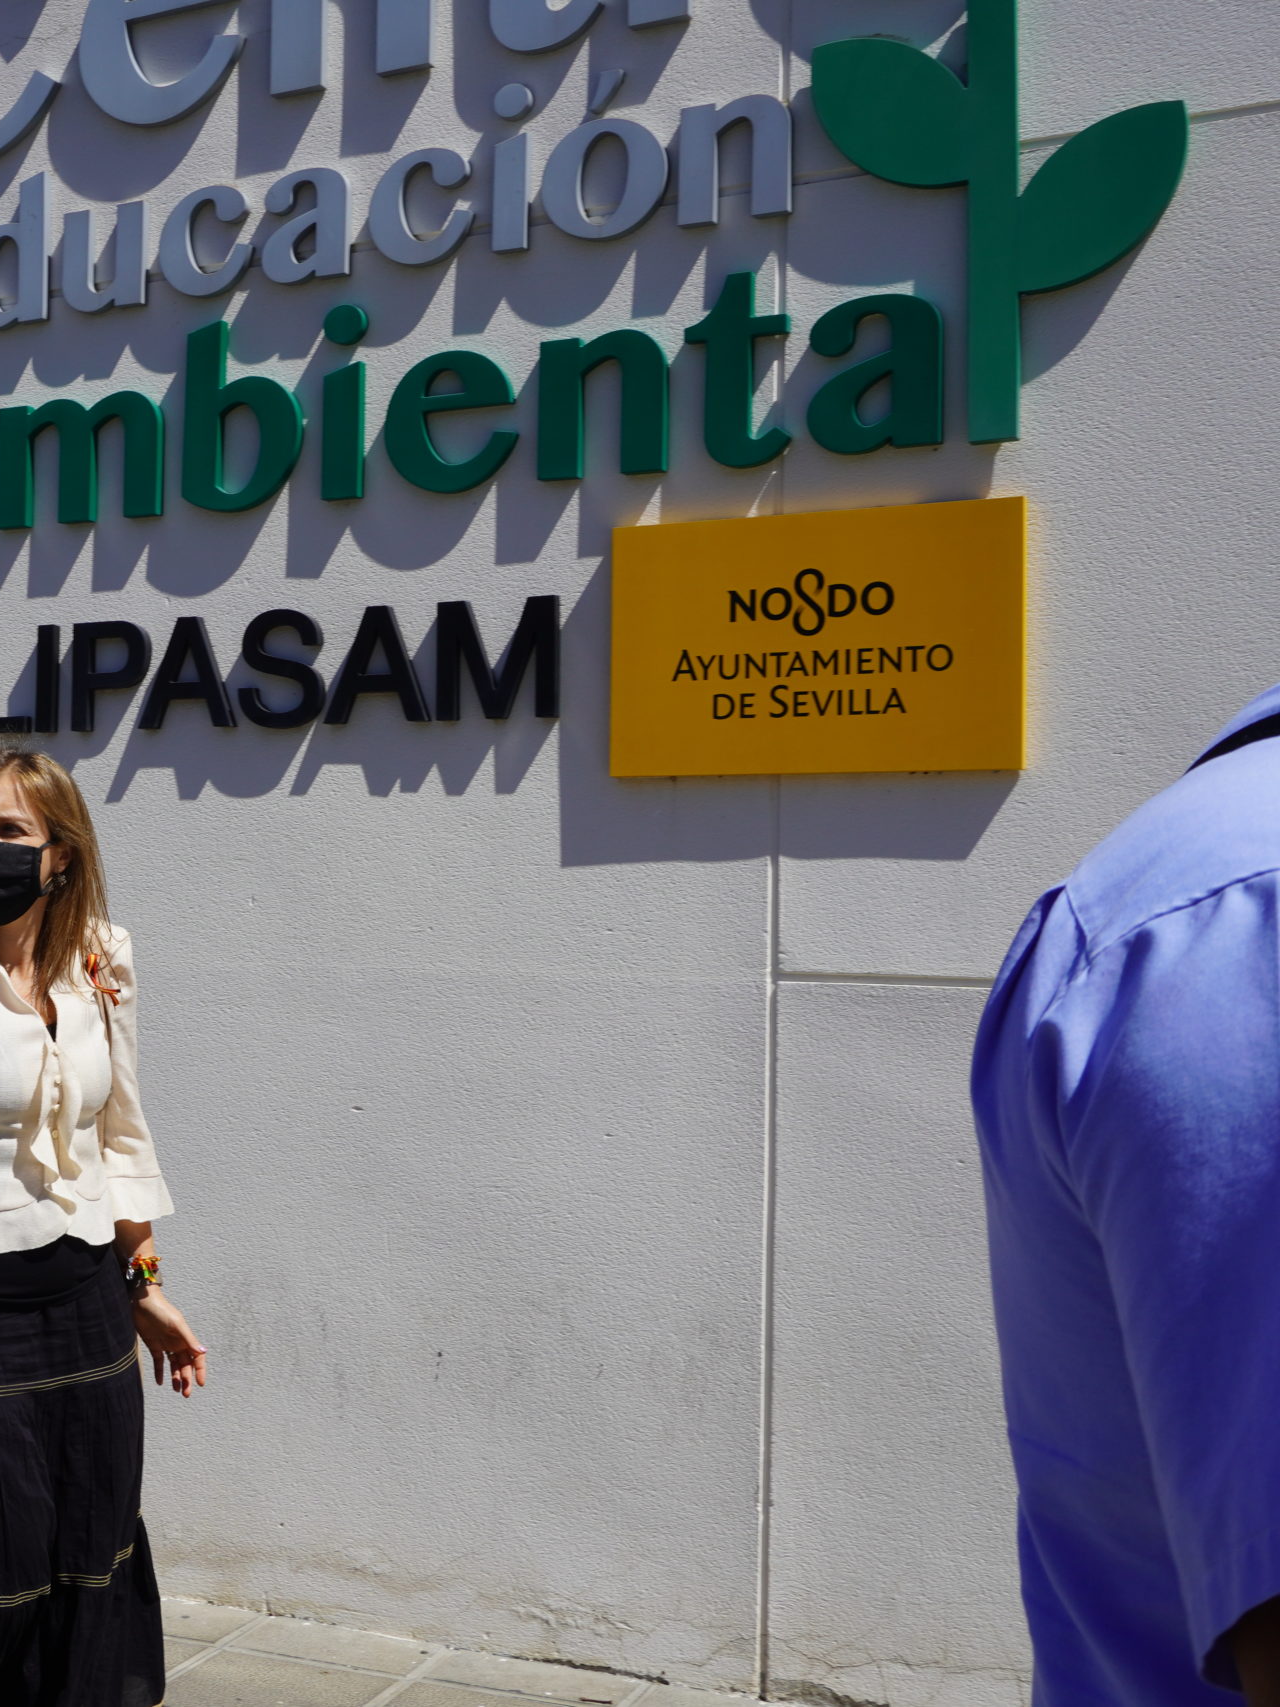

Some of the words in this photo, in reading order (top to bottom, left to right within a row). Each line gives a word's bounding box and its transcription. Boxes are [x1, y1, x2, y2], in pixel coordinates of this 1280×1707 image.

[671, 643, 955, 682] AYUNTAMIENTO
[711, 693, 757, 720] DE
[768, 684, 908, 719] SEVILLA
